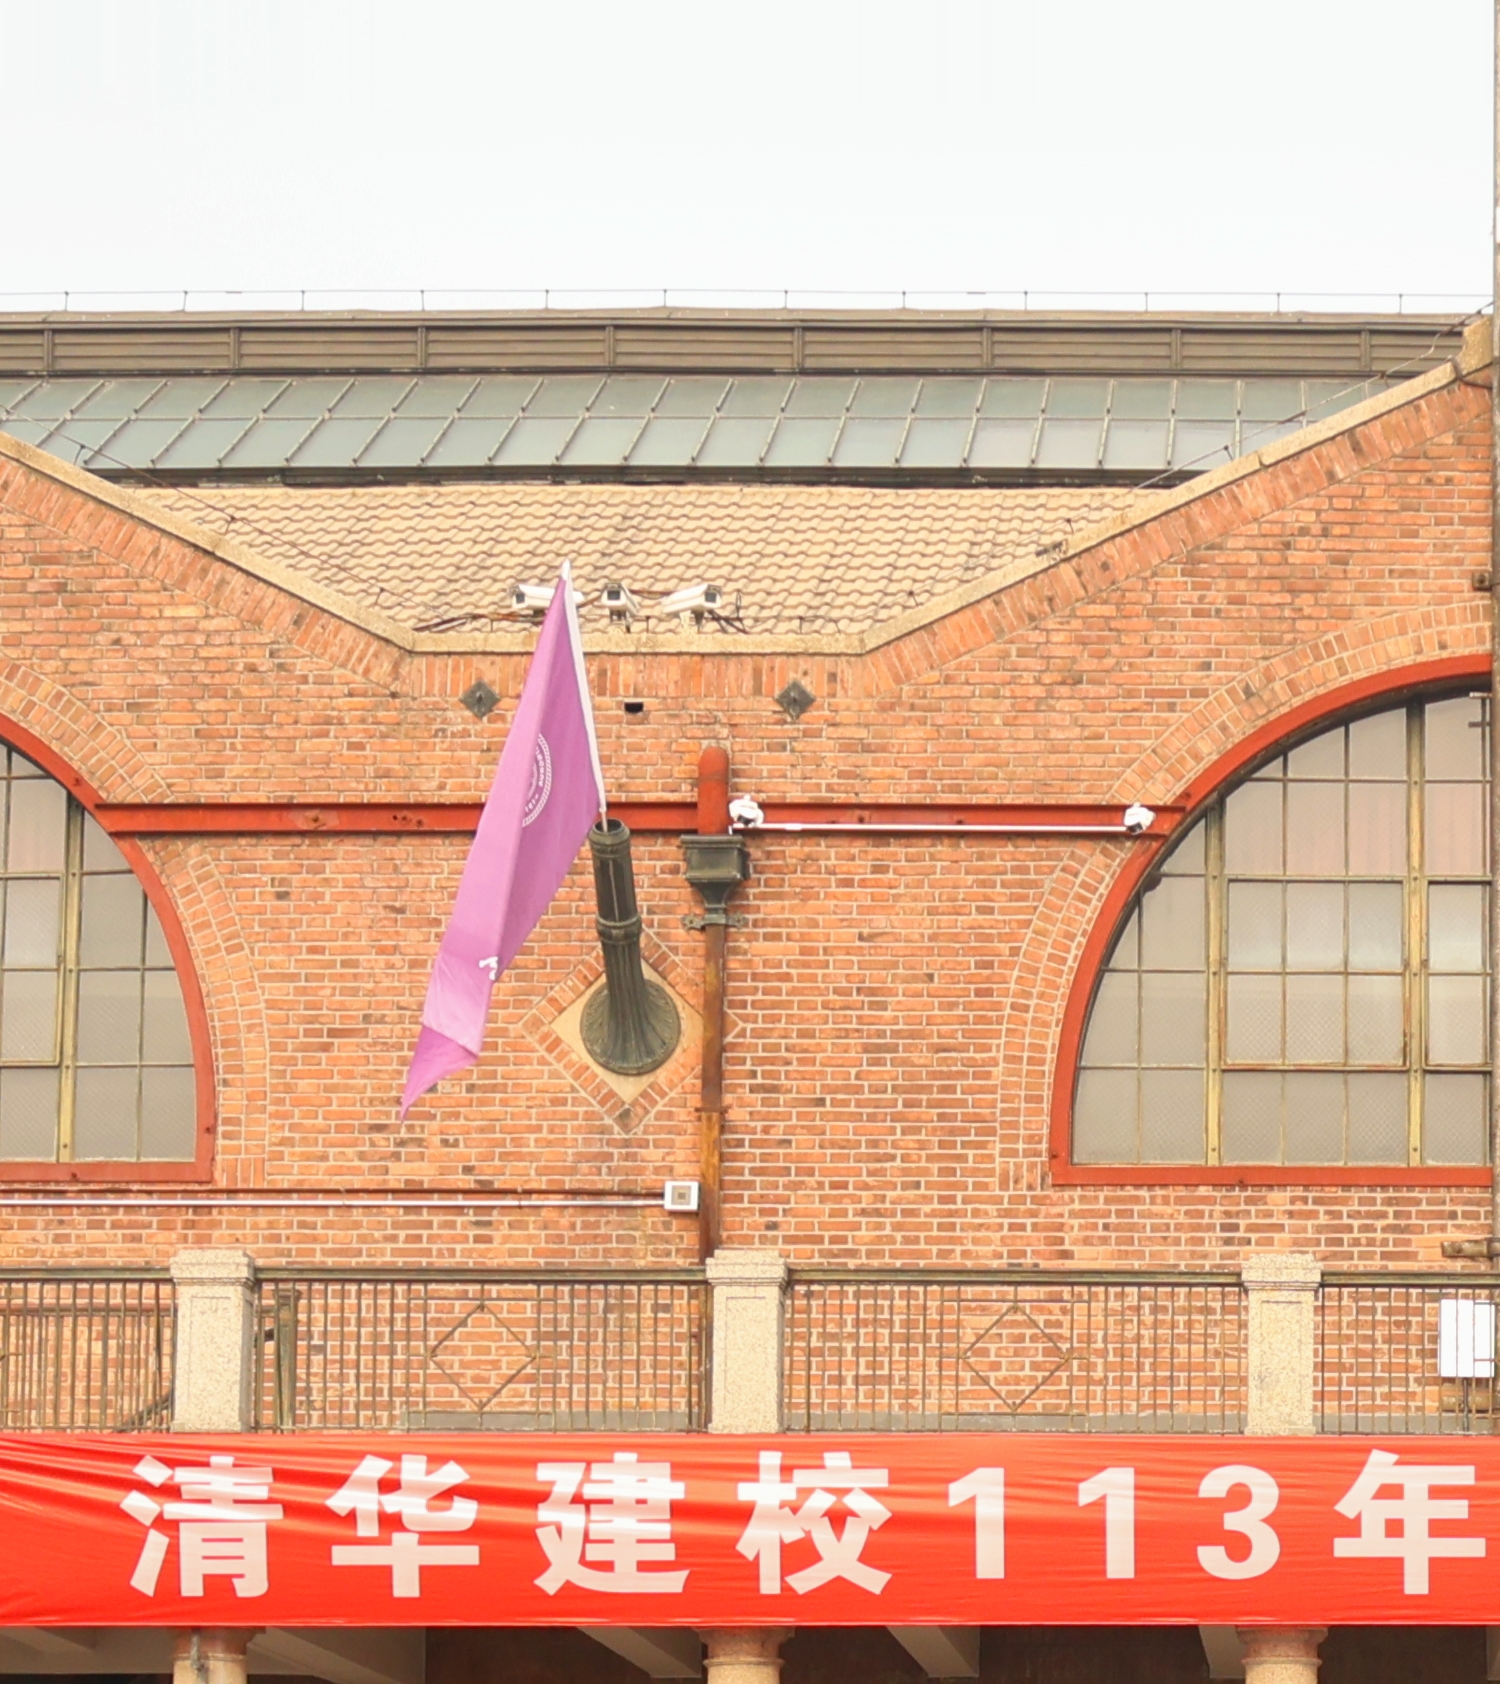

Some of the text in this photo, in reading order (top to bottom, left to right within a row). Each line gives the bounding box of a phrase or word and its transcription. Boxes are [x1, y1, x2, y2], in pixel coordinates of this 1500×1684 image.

[119, 1448, 1487, 1598] 清华建校113年
